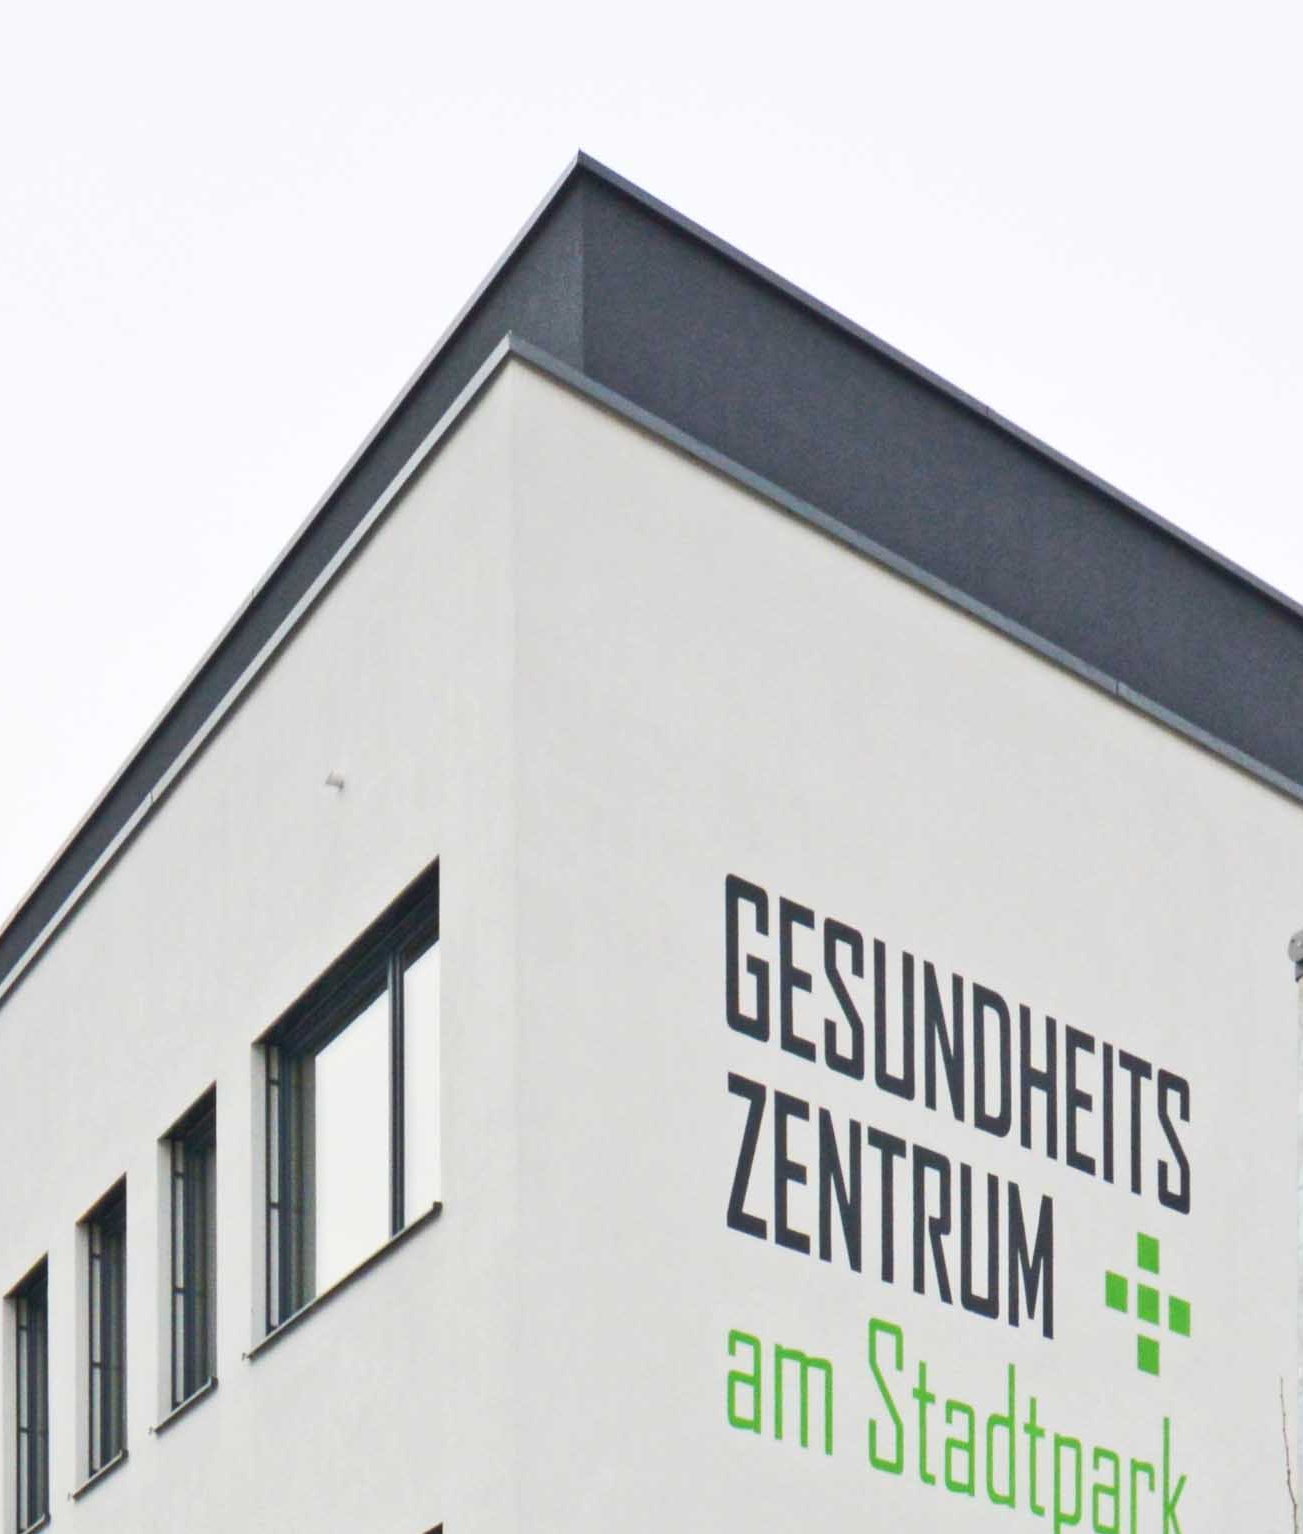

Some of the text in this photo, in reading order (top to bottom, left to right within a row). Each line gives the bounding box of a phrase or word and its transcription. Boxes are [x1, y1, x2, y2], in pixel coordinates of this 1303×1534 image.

[725, 872, 1191, 1216] GESUNDHEITS
[726, 1070, 1054, 1341] ZENTRUM
[726, 1328, 834, 1456] am
